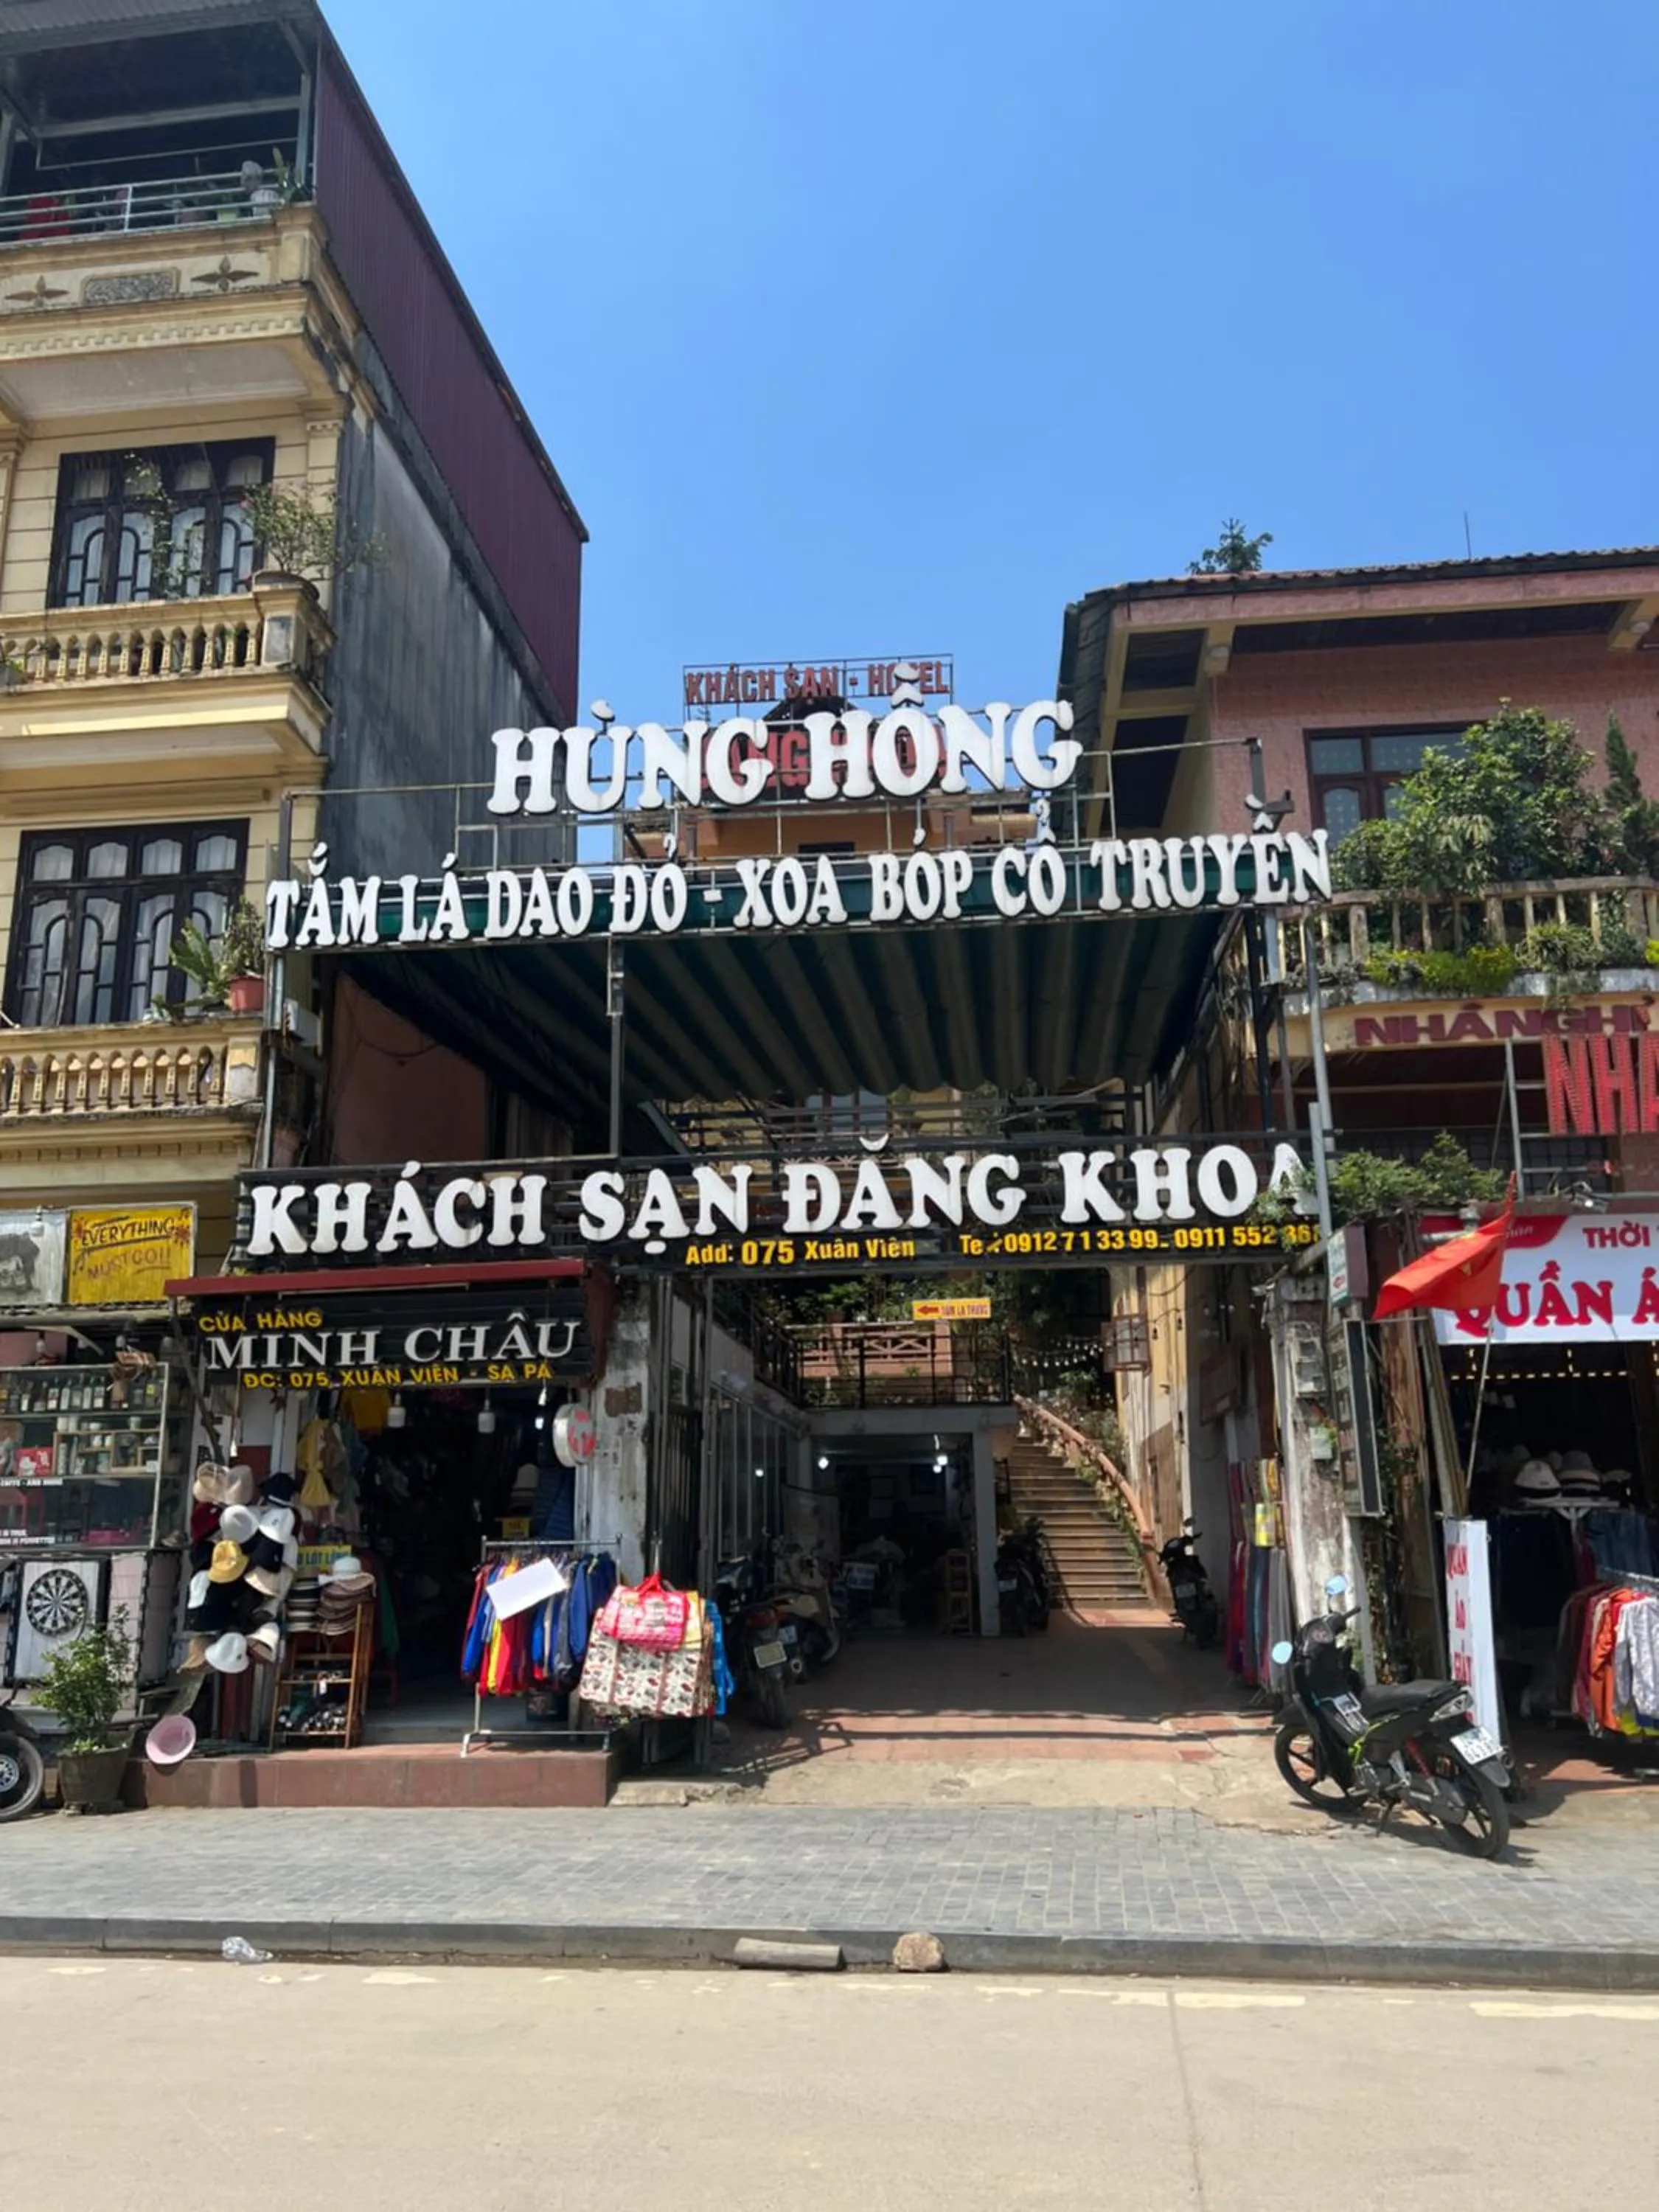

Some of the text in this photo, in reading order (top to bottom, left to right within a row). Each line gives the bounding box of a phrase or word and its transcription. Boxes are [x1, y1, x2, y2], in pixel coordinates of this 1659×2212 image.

[686, 662, 775, 705] KHÁCH
[487, 699, 773, 814] HÙNG
[804, 664, 1083, 801] HỒNG
[266, 842, 380, 948] TẮM
[399, 853, 469, 942] LÁ
[485, 867, 593, 939] DAO
[609, 835, 686, 933] ĐỎ
[734, 855, 847, 928] XOA
[869, 827, 973, 923] BÓP
[992, 799, 1066, 917] CỔ
[1090, 794, 1332, 911] TRUYỀN
[248, 1134, 1319, 1254] KHÁCH SẠN ĐĂNG KHOA
[82, 1217, 175, 1245] EVERYTHING
[1582, 1220, 1651, 1248] THỜI
[686, 1242, 734, 1265] Add:
[742, 1240, 794, 1265] 075
[805, 1238, 858, 1261] Xuân
[866, 1237, 915, 1259] Viên
[257, 1308, 322, 1329] HÀNG
[206, 1312, 581, 1369] MINH CHÂU
[341, 1366, 402, 1386] XUÂN
[410, 1363, 459, 1384] VIÊN
[487, 1365, 515, 1381] SA
